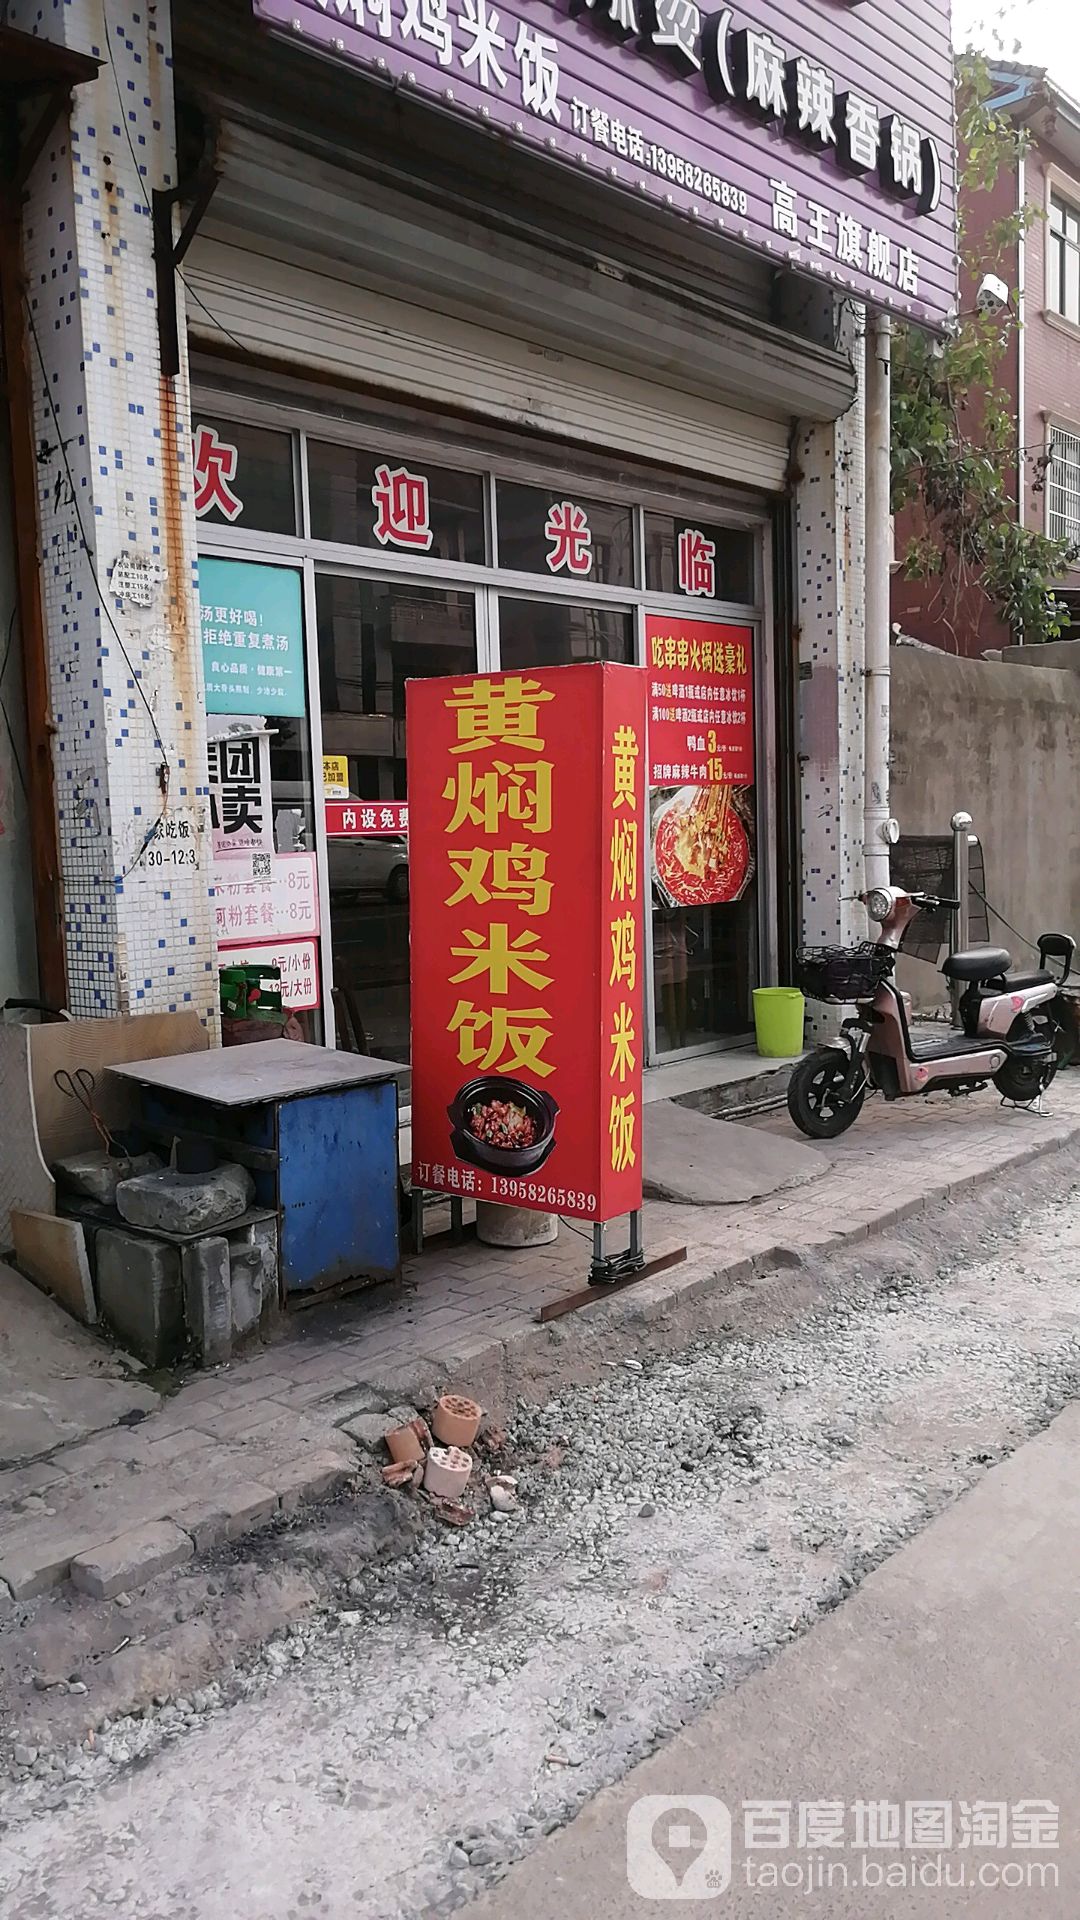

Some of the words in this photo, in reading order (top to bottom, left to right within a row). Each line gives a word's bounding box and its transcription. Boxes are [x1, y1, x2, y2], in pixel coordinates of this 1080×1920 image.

[769, 178, 920, 296] 高王旗舰店
[204, 627, 289, 652] 拒绝重复煮汤
[441, 677, 557, 1079] 黄焖鸡米饭
[609, 725, 639, 1172] 黄焖鸡米饭
